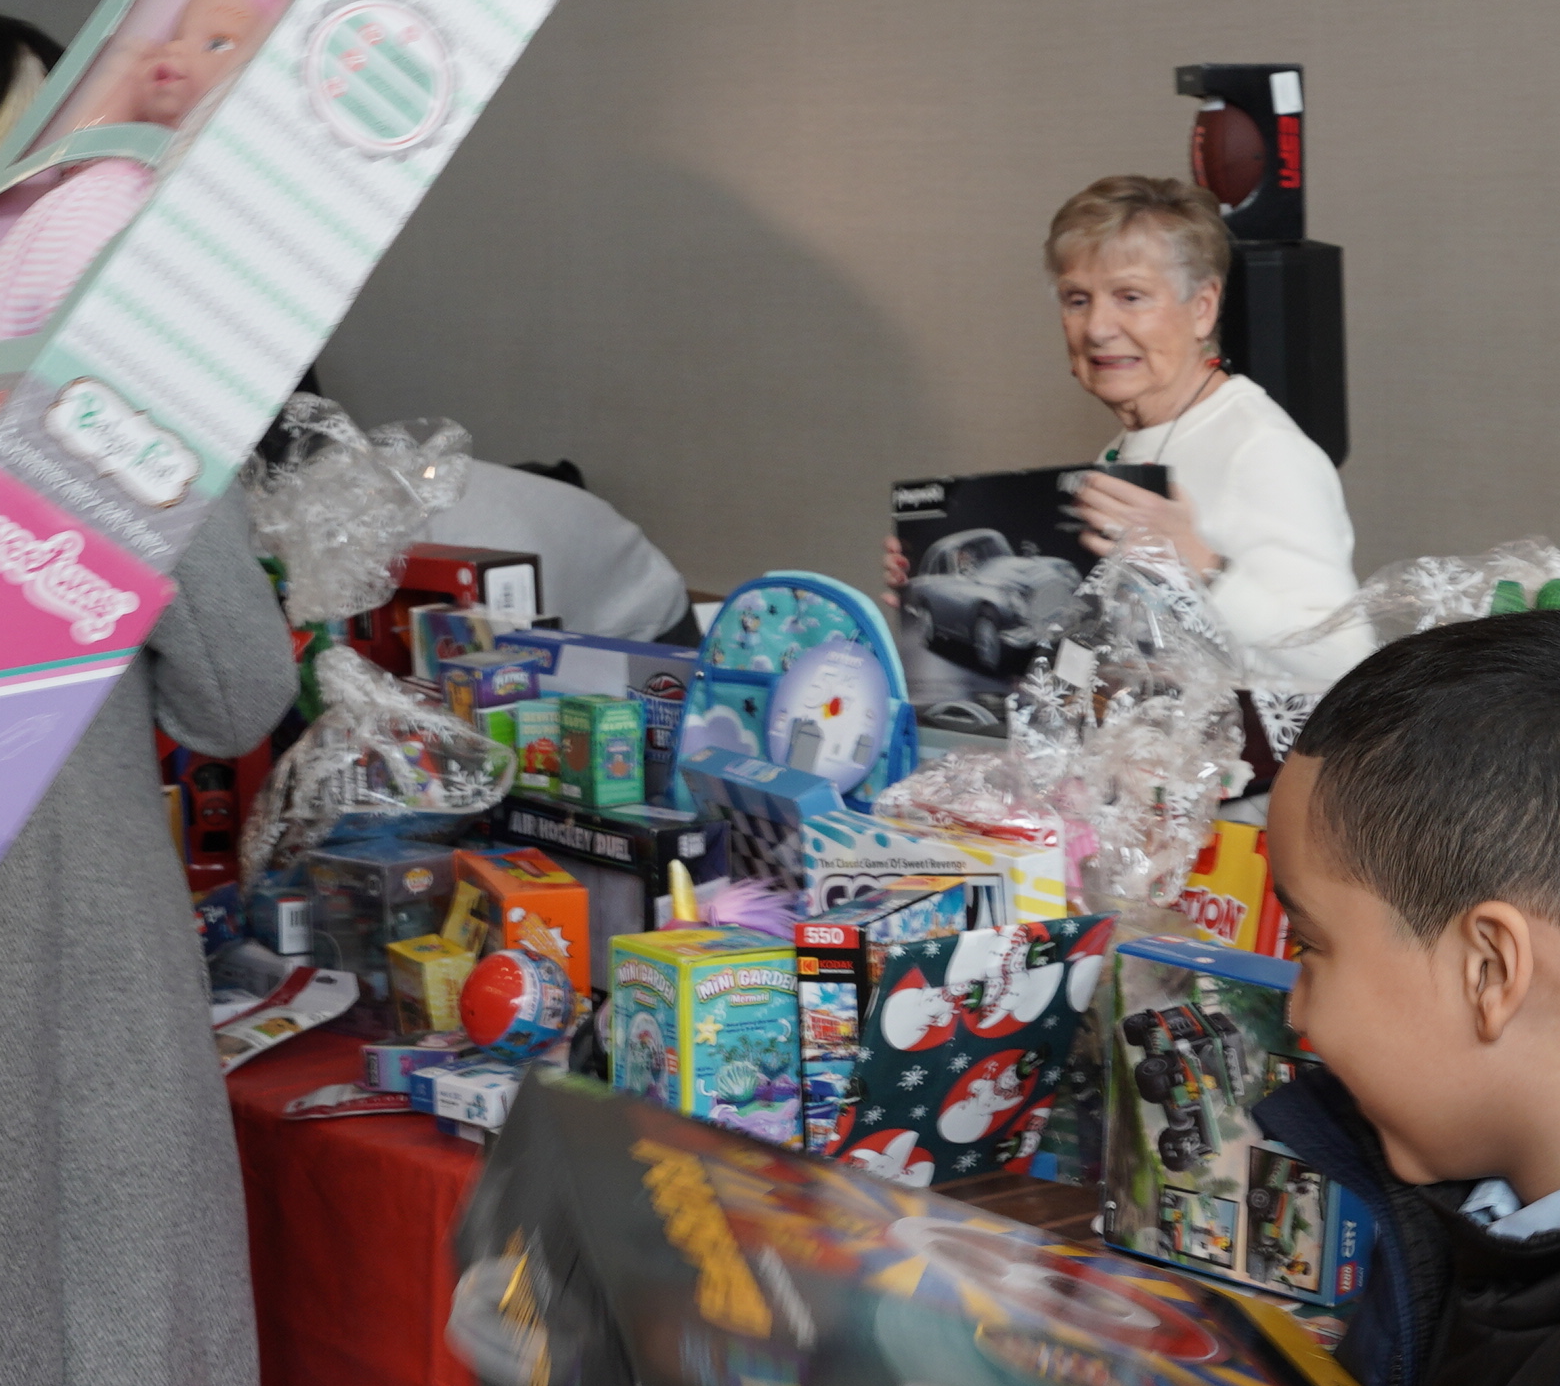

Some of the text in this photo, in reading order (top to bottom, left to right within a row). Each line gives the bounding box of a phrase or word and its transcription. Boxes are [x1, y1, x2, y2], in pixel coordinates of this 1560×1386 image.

[509, 811, 633, 862] AIR HOCKEY DUEL
[820, 859, 967, 871] The Classic Game Of Sweet Revenge
[804, 926, 845, 945] 550
[820, 959, 854, 970] KODAK
